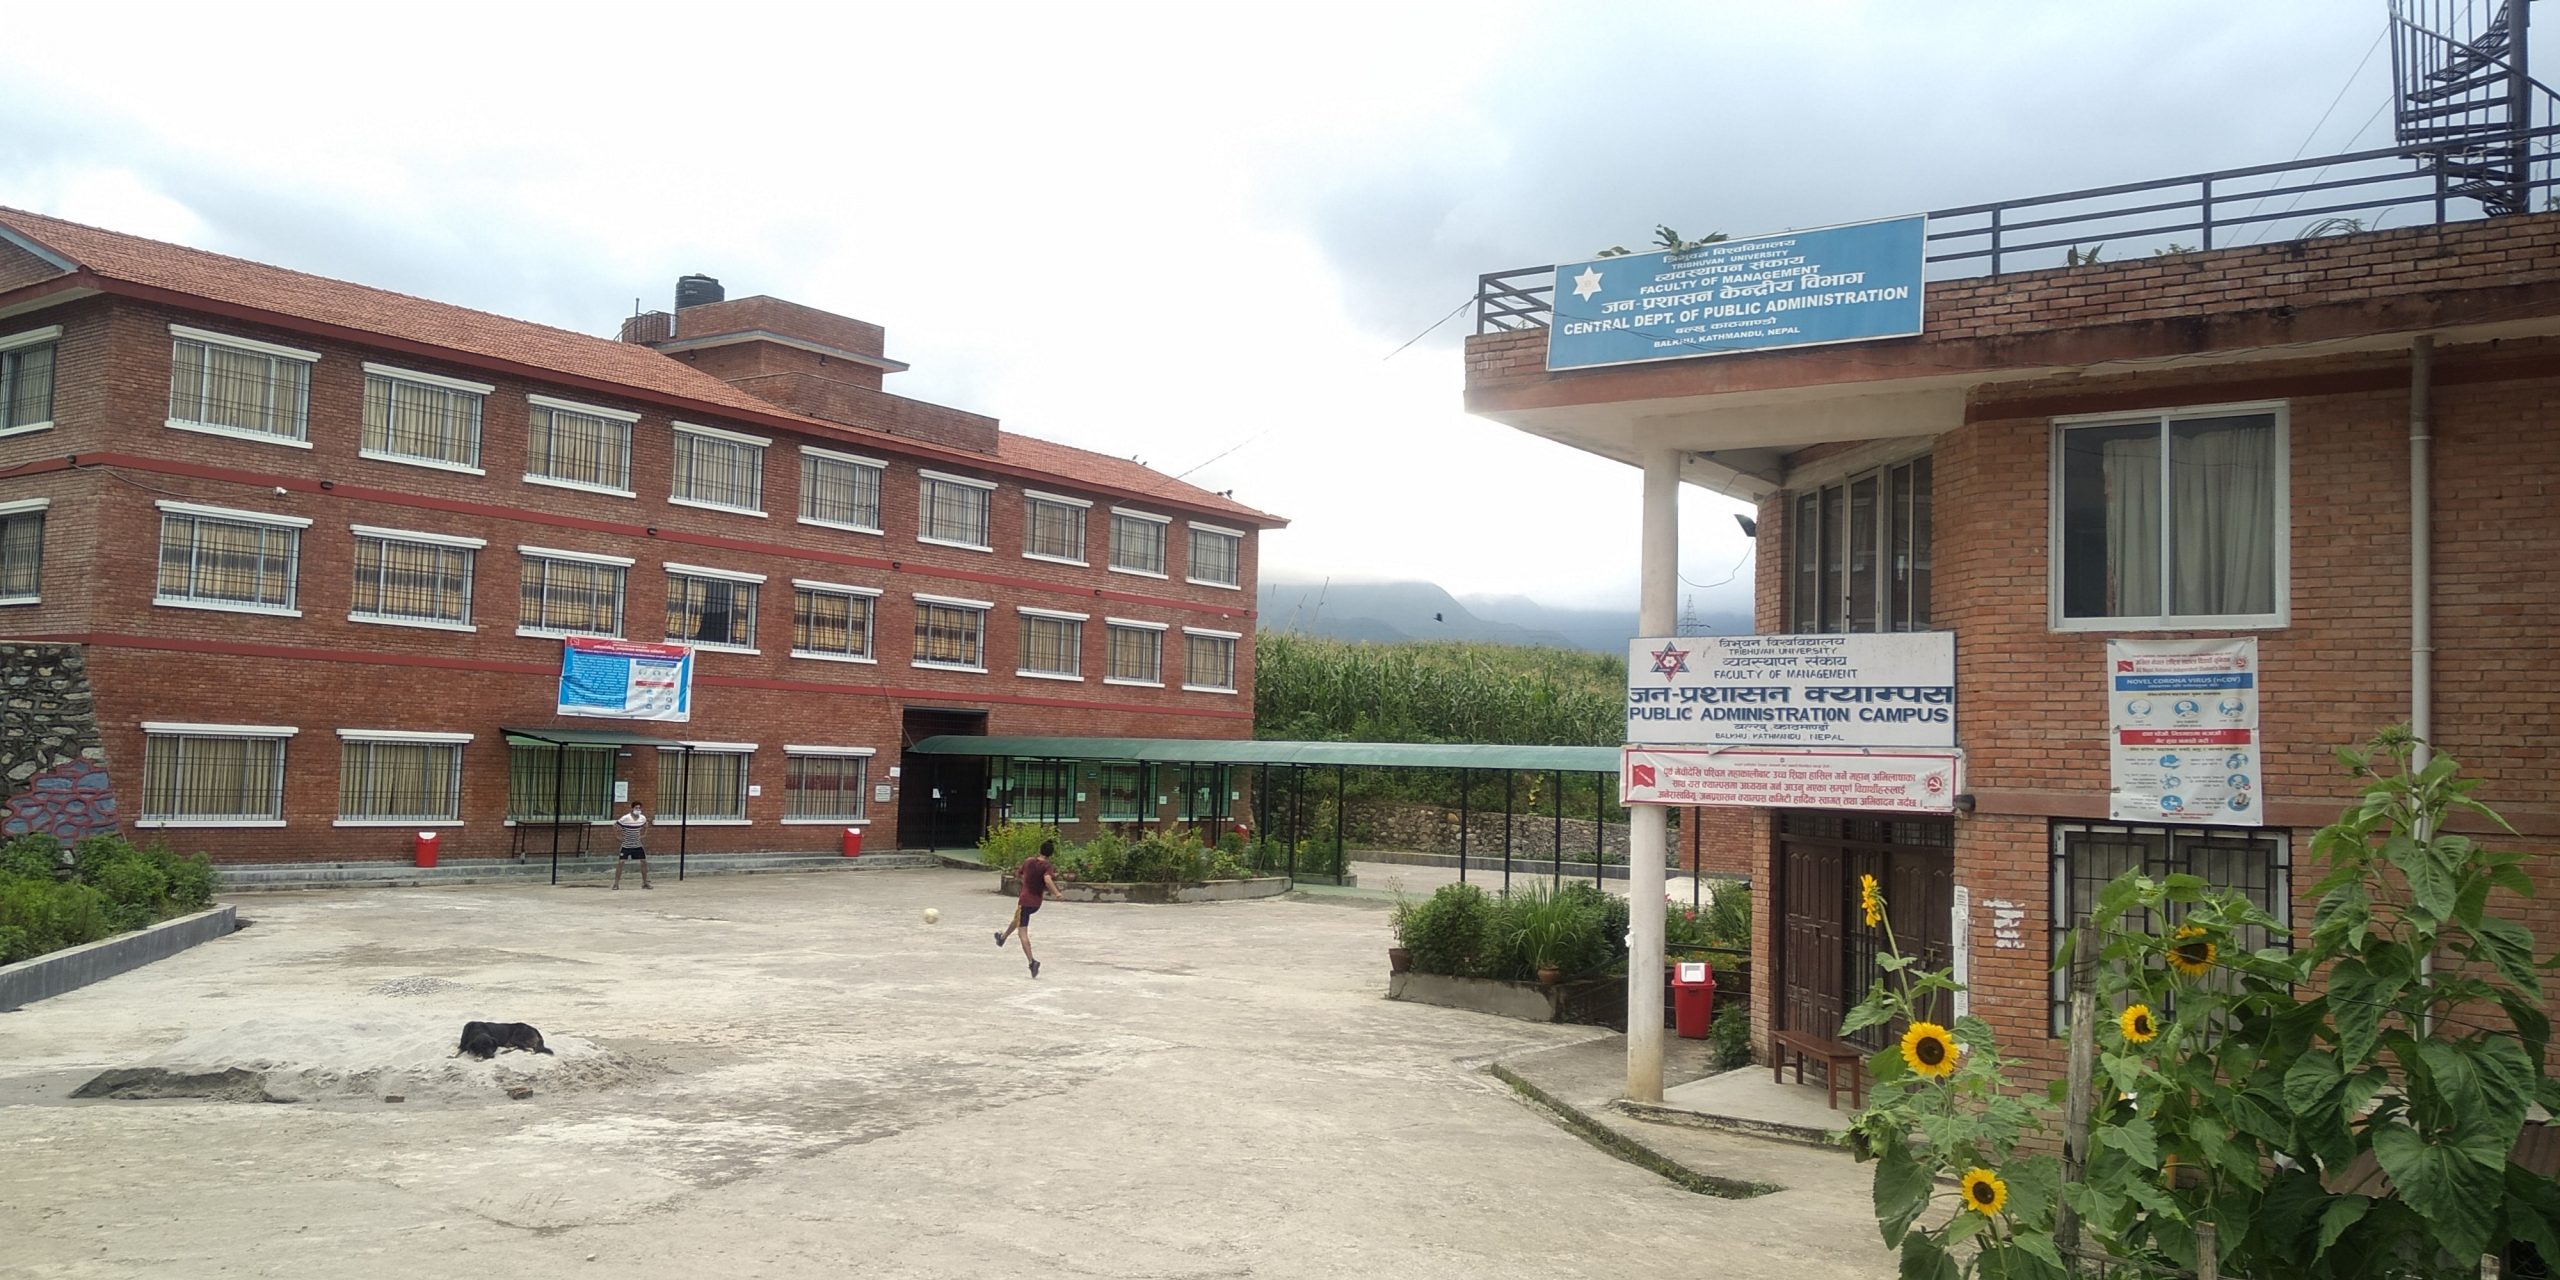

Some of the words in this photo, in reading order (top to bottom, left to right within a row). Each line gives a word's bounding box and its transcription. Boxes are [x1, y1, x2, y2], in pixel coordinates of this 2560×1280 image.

[1655, 263, 1744, 282] व्यवस्थापन
[1750, 256, 1806, 270] संकाय
[1672, 258, 1725, 271] TRIBHUVAN
[1731, 250, 1788, 262] UNIVERSITY
[1640, 280, 1697, 295] FACULTY
[1701, 276, 1718, 288] OF
[1722, 264, 1821, 285] MANAGEMENT
[1601, 290, 1714, 314] जन-प्रशासन
[1720, 280, 1795, 299] केन्द्रीय
[1801, 272, 1866, 291] विभाग
[1564, 316, 1630, 336] CENTRAL
[1634, 312, 1676, 328] DEPT.
[1680, 309, 1700, 323] OF
[1704, 301, 1761, 319] PUBLIC
[1765, 286, 1909, 313] ADMINISTRATION
[1699, 329, 1764, 343] KATHMANDU,
[1768, 326, 1801, 337] NEPAL
[1729, 648, 1775, 656] TRIBHUVAN
[1779, 647, 1838, 655] UNIVERSITY
[1722, 656, 1799, 668] व्यवस्थापन
[1805, 655, 1848, 668] संकाय
[1714, 670, 1762, 680] FACULTY
[1769, 670, 1781, 680] OF
[1786, 669, 1858, 679] MANAGEMENT
[1629, 686, 1792, 704] जन-प्रशासन
[1804, 686, 1954, 705] क्याम्पस
[1630, 707, 1693, 721] PUBLIC
[1700, 707, 1851, 723] ADMINISTRATION
[1858, 707, 1950, 724] CAMPUS
[1809, 733, 1845, 741] NEPAL
